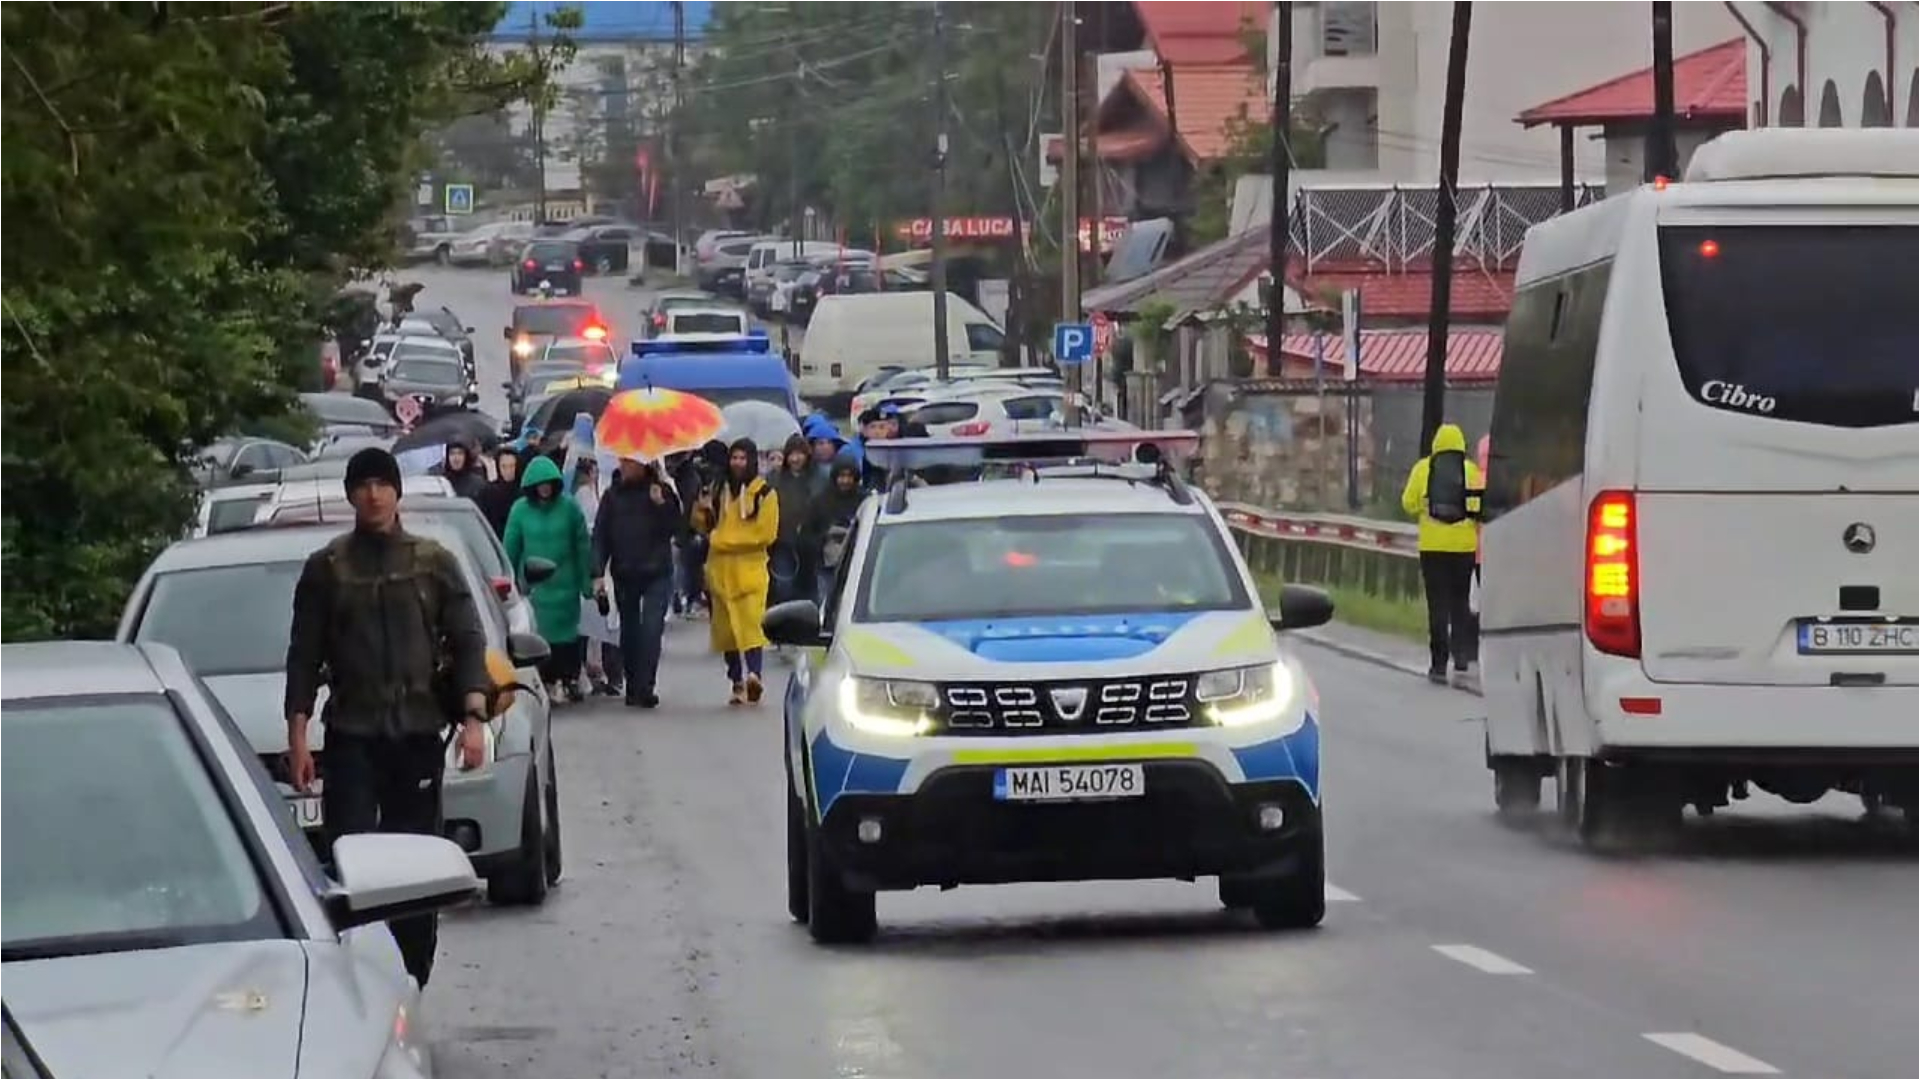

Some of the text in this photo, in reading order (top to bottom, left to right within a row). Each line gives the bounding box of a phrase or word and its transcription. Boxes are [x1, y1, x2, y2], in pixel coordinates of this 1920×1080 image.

[1063, 328, 1084, 358] P
[1701, 380, 1776, 412] Cibro
[1813, 626, 1828, 647] B
[1836, 626, 1862, 647] 110
[1012, 767, 1135, 796] MAI 54078
